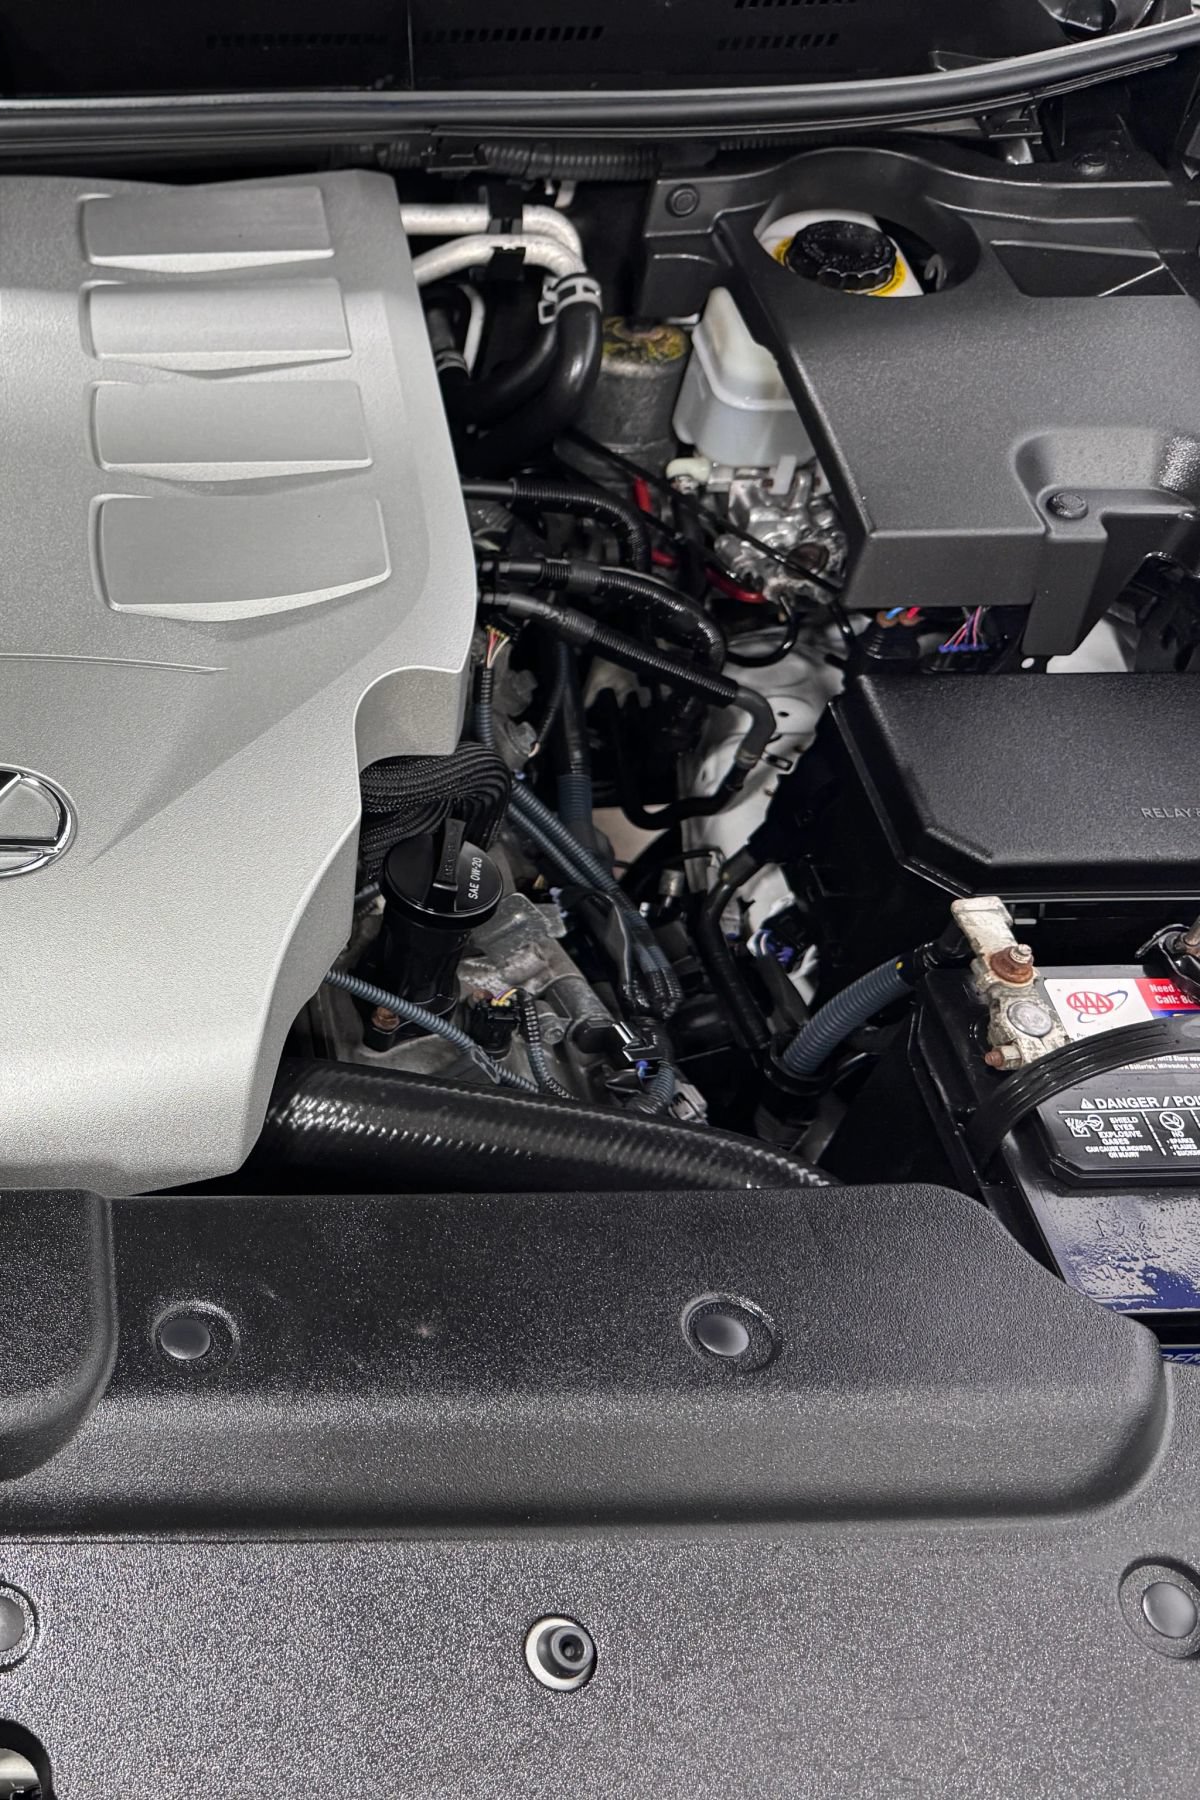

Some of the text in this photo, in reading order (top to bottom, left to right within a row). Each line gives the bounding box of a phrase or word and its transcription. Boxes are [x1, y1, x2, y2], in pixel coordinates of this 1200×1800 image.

[1141, 807, 1191, 818] RELAY
[468, 857, 482, 900] SAE 0W-20
[1149, 984, 1175, 993] Need
[1070, 991, 1109, 1015] AAA
[1155, 995, 1180, 1004] Call:
[1094, 1096, 1160, 1109] DANGER
[1109, 1116, 1139, 1124] SHIELD
[1112, 1123, 1135, 1131] EYES
[1098, 1130, 1143, 1139] EXPLOSIVE
[1171, 1130, 1185, 1138] NO
